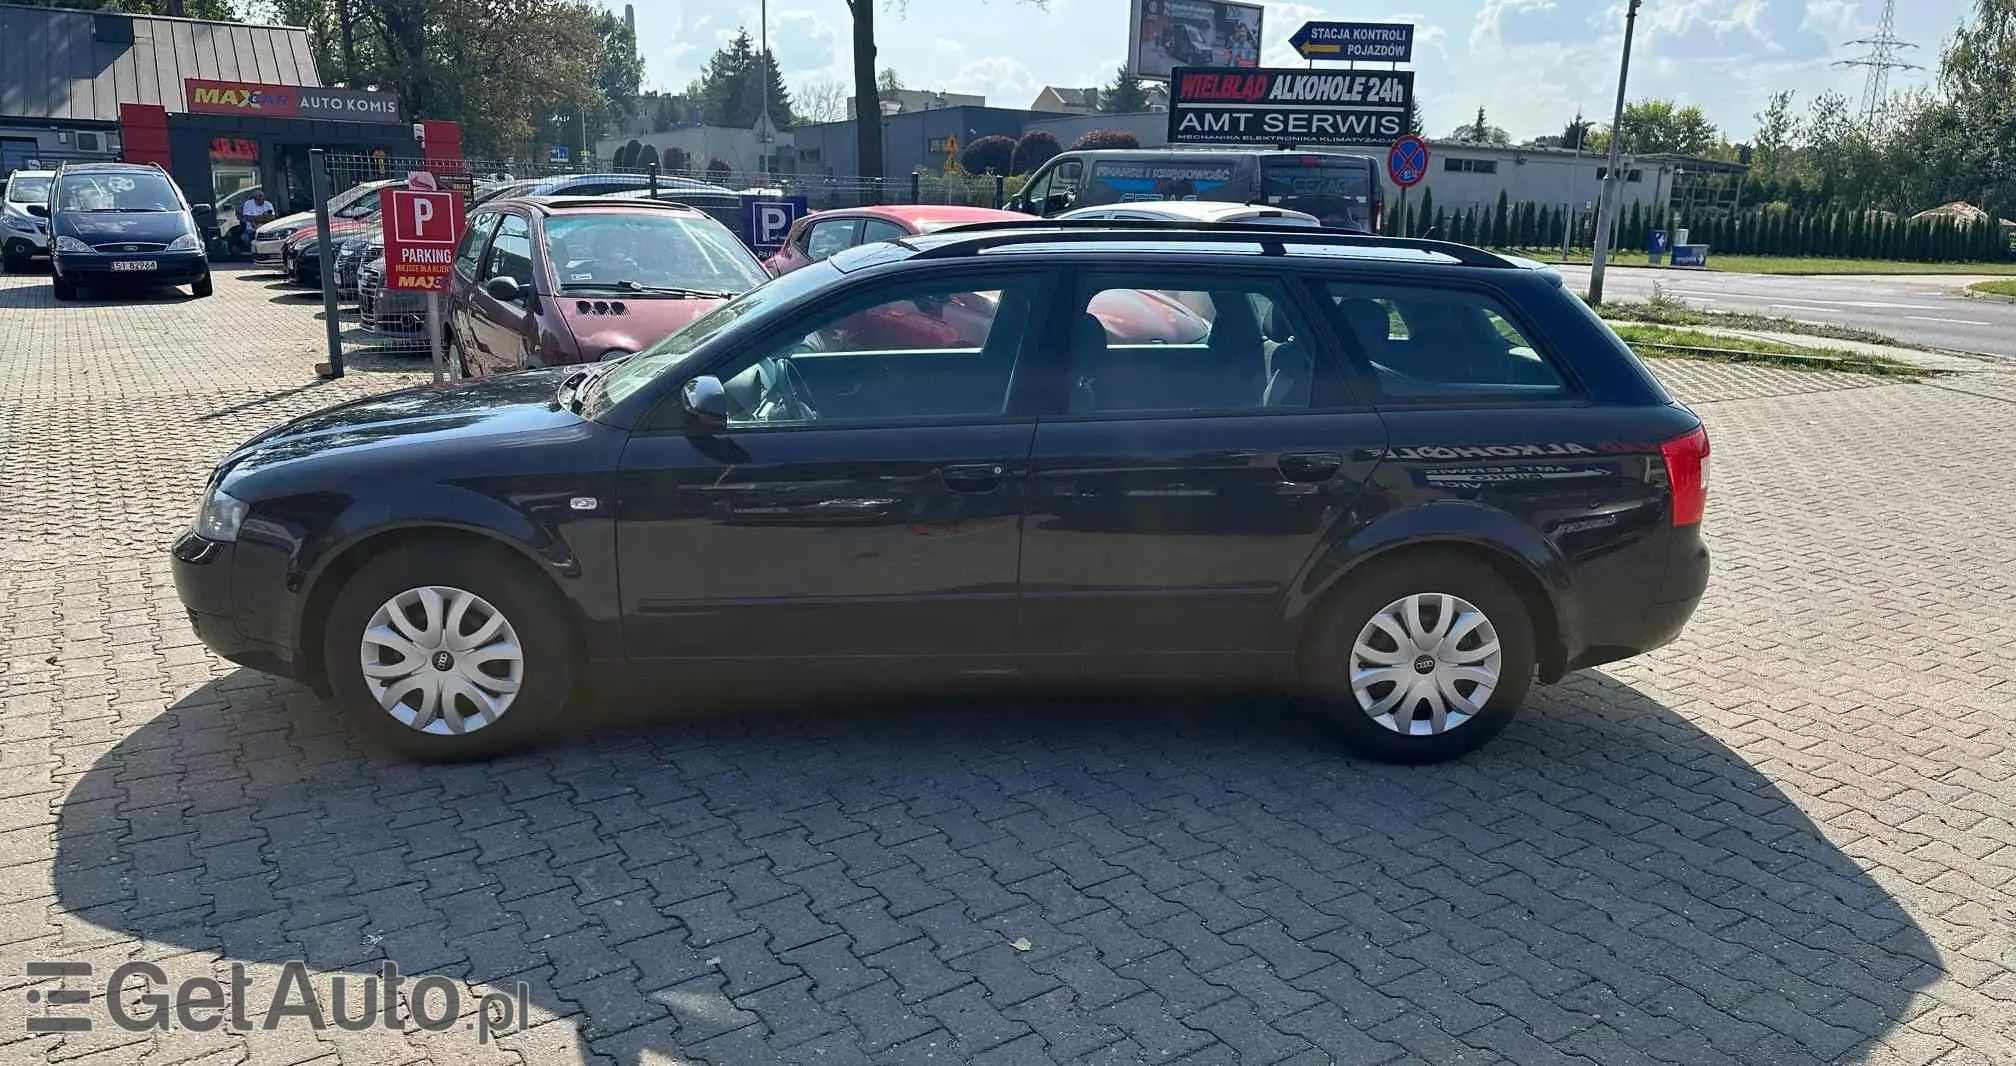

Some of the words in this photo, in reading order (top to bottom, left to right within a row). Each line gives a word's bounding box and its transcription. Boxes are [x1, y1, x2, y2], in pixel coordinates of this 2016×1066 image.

[1311, 27, 1350, 40] STACJA
[1353, 29, 1406, 41] KONTROLI
[1347, 42, 1405, 57] POJAZDÓW
[1268, 75, 1367, 101] ALKOHOLE
[1366, 76, 1404, 102] 24h
[300, 95, 343, 110] AUTO
[347, 98, 396, 113] KOMIS
[1178, 112, 1254, 131] AMT
[1263, 113, 1400, 134] SERWIS
[414, 198, 434, 236] P
[762, 208, 786, 242] P
[401, 248, 452, 263] PARKING
